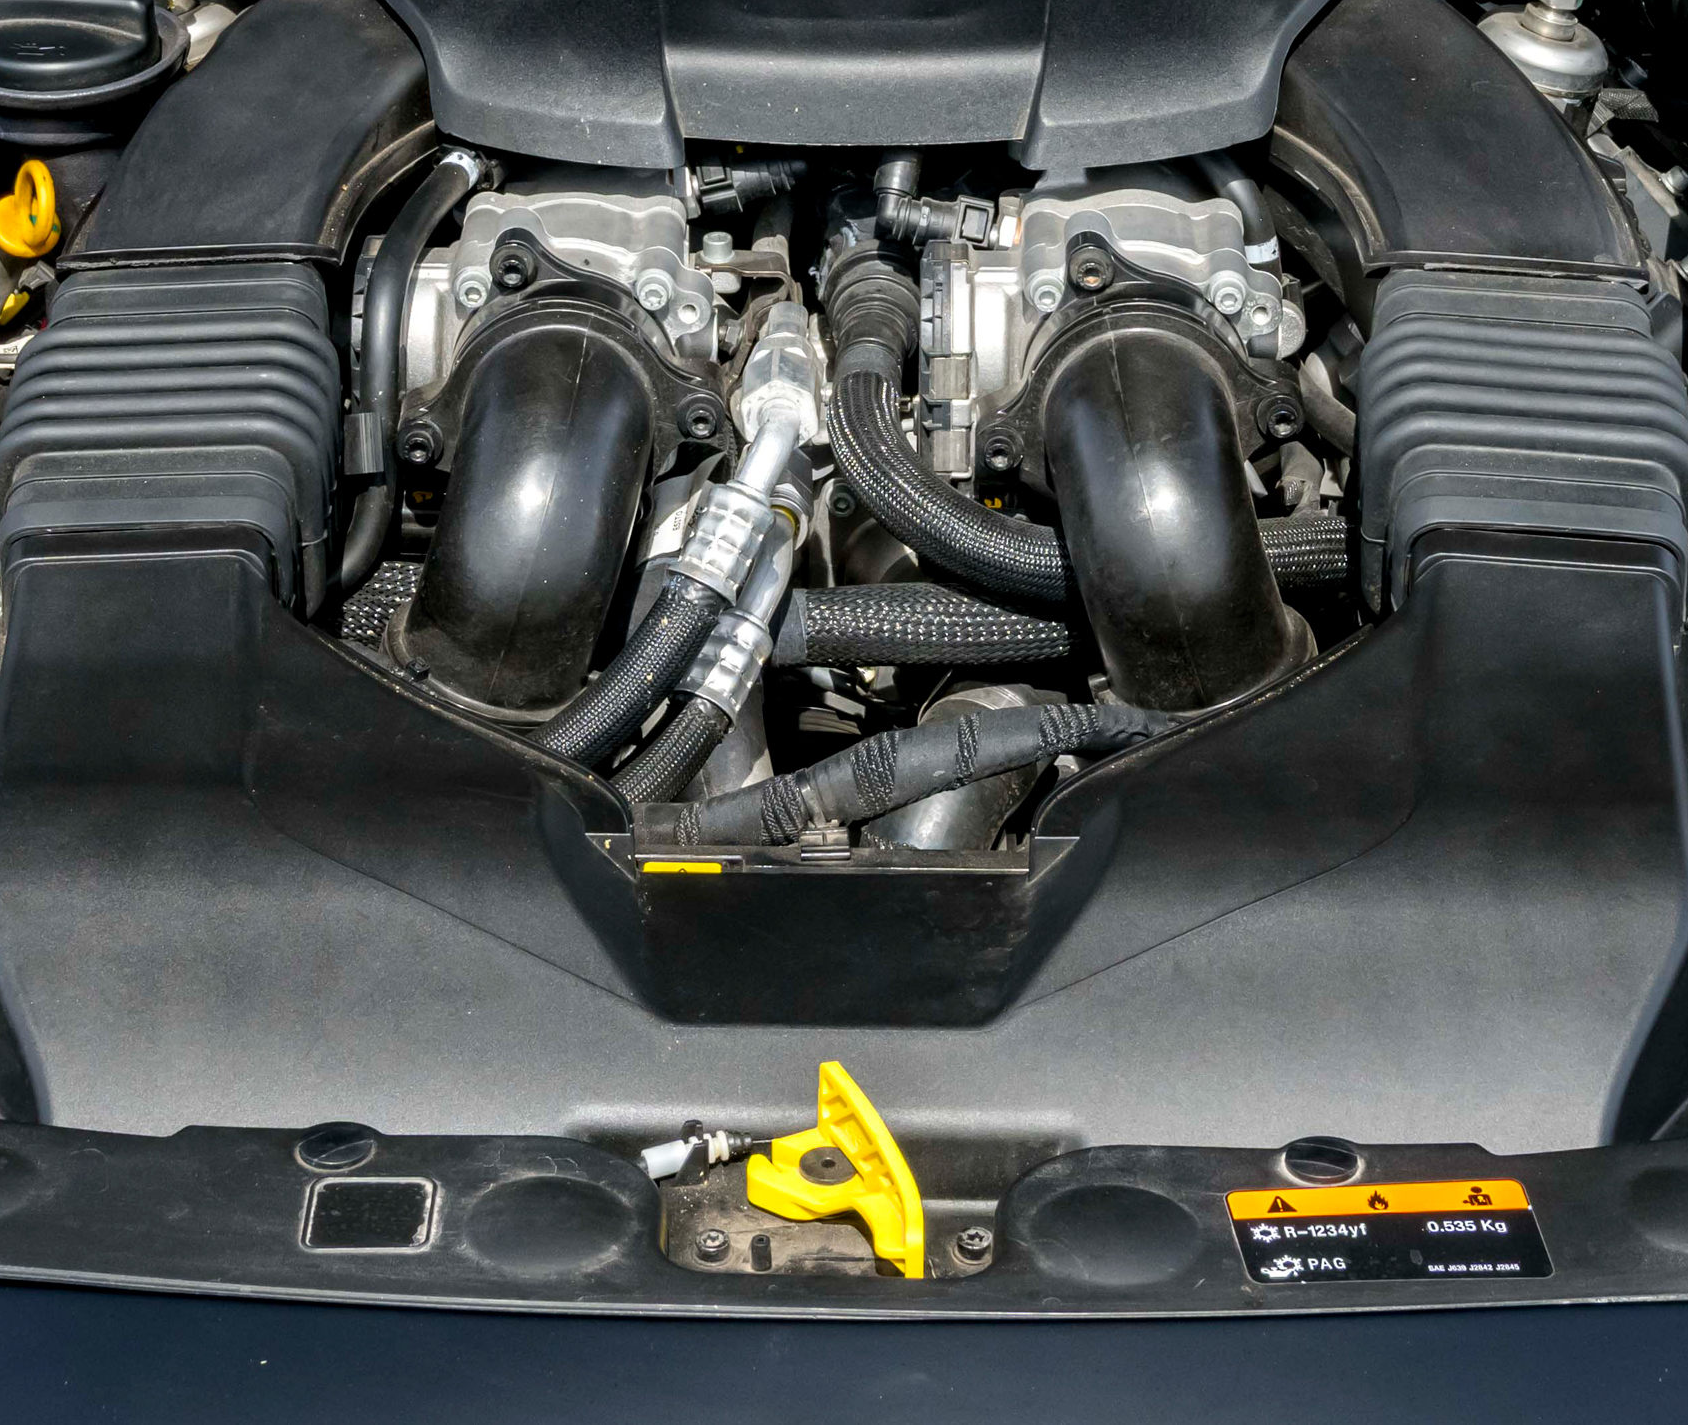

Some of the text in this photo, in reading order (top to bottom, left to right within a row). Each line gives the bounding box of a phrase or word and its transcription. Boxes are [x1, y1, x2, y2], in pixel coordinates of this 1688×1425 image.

[1284, 1219, 1508, 1239] R-1234yf 0.535 Kg
[1307, 1257, 1346, 1271] PAG
[1427, 1265, 1445, 1273] SAE
